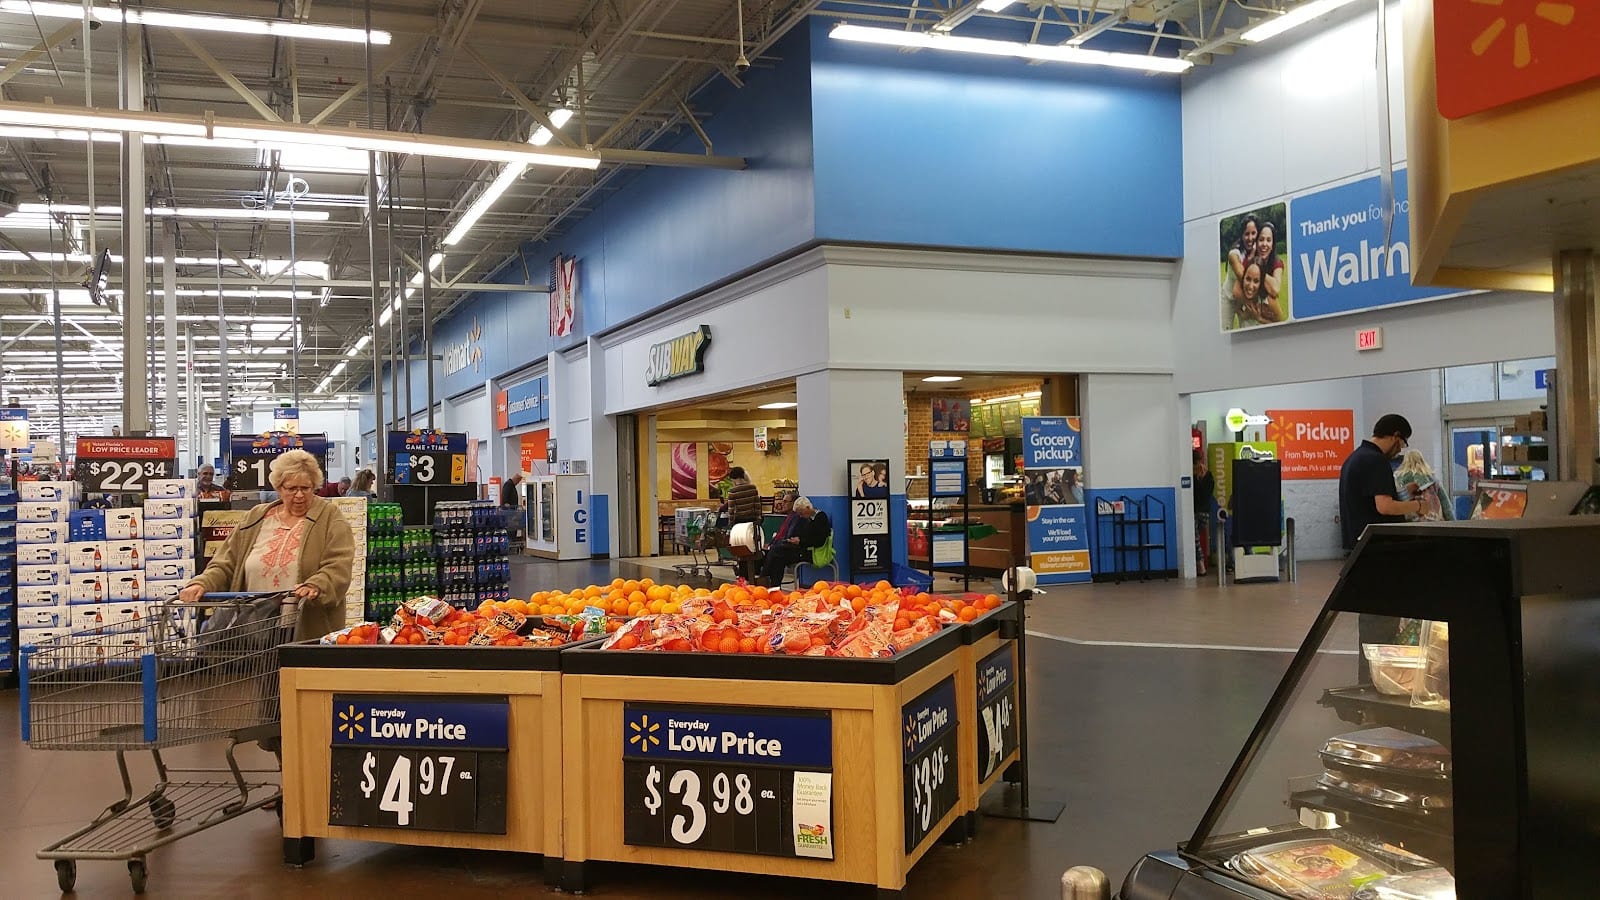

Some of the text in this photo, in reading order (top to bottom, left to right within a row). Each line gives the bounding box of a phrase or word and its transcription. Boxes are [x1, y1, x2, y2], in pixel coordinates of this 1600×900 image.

[1300, 214, 1340, 236] Thank
[1341, 211, 1367, 231] you
[1300, 239, 1409, 292] Walm
[1359, 331, 1376, 347] EXIT
[443, 332, 471, 377] Walmart
[646, 328, 705, 385] SUBWAY
[1030, 433, 1075, 448] Grocery
[1295, 422, 1350, 444] Pickup
[1034, 446, 1074, 463] pickup
[1285, 450, 1300, 459] From
[1302, 450, 1316, 460] Toys
[1324, 449, 1338, 458] TVs.
[409, 455, 435, 482] $3
[1215, 447, 1226, 507] minute
[573, 490, 588, 543] ICE
[1041, 517, 1053, 525] Stay
[863, 545, 878, 558] 12
[986, 667, 1007, 695] Low Price
[370, 708, 406, 719] Everyday
[370, 718, 467, 740] Low Price
[668, 719, 710, 731] Everyday
[918, 706, 948, 745] Low Price
[668, 728, 782, 757] Low Price
[459, 771, 473, 780] ea.
[760, 789, 776, 799] ea.
[797, 834, 828, 845] FRESH
